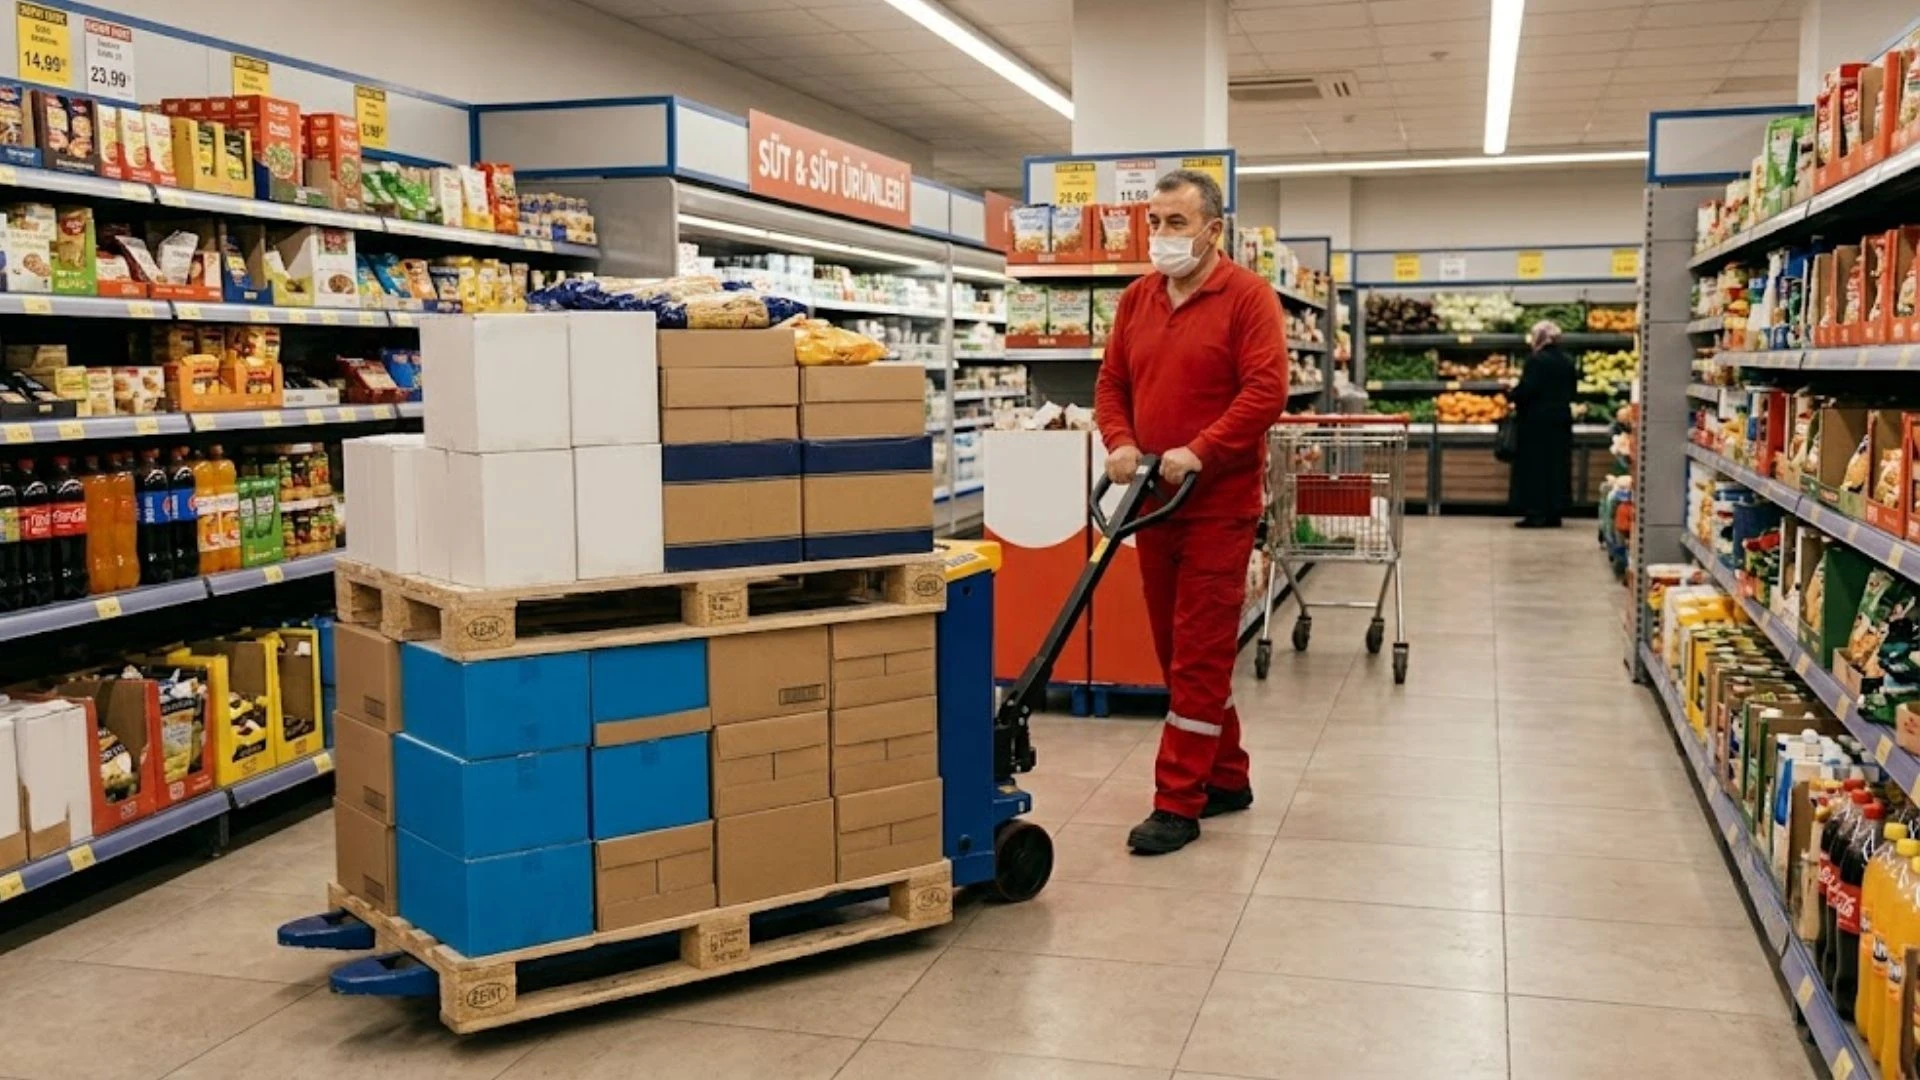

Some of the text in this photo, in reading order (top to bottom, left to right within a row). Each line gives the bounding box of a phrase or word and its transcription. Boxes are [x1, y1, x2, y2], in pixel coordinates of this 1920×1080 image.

[91, 66, 126, 87] 23,99
[758, 132, 791, 182] SÜT
[795, 149, 808, 186] &
[809, 149, 839, 195] SÜT
